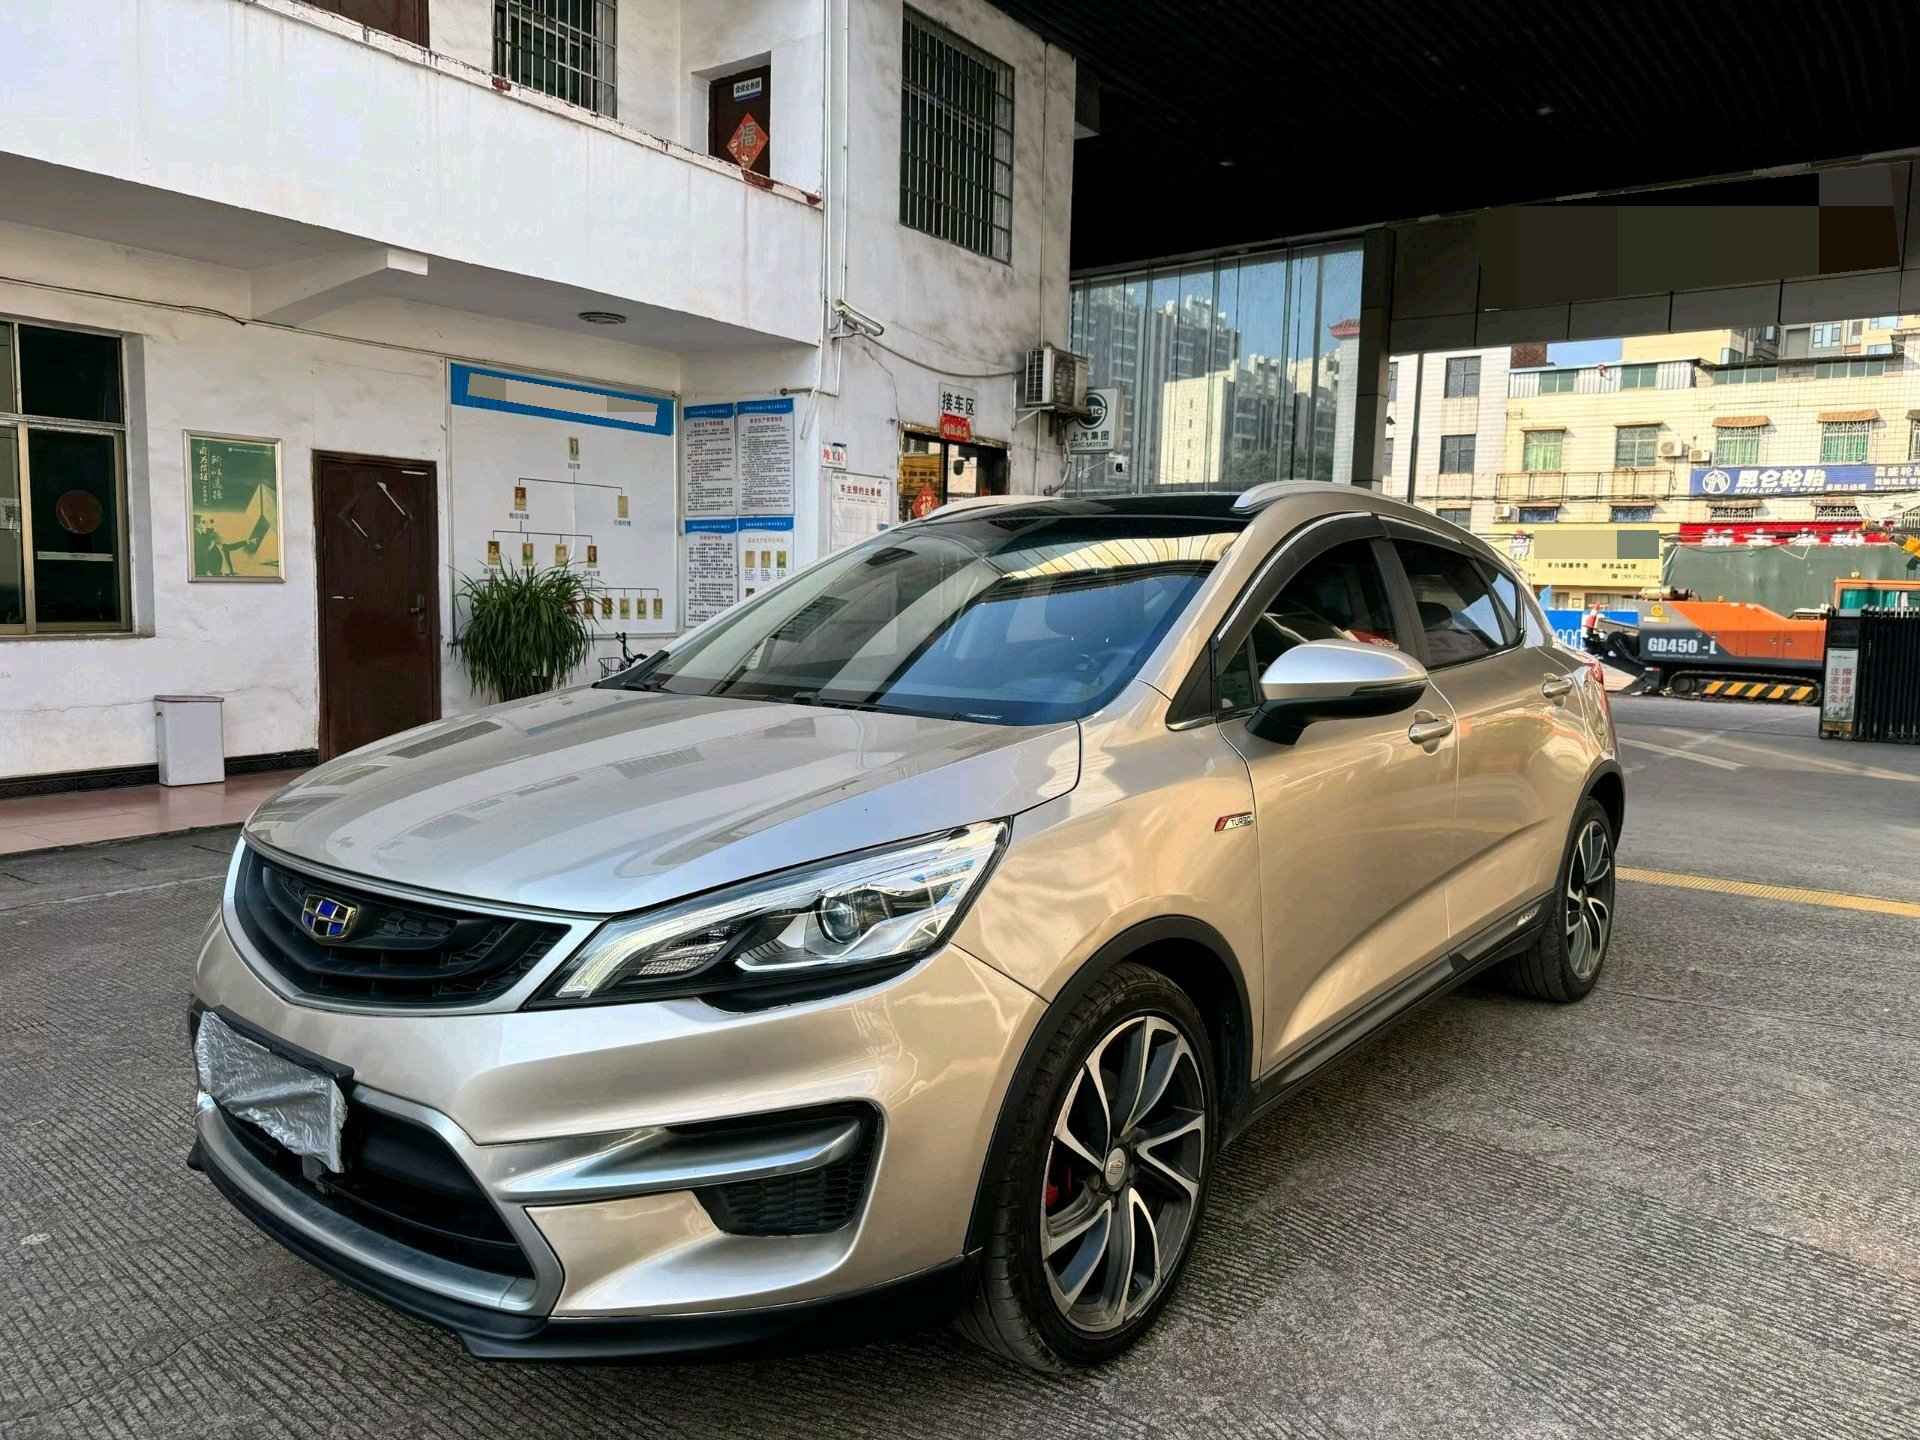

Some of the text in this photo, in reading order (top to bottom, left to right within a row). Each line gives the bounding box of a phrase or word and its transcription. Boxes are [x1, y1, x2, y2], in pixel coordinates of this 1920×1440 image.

[739, 122, 757, 147] 福
[942, 391, 975, 416] 接车区
[1070, 431, 1109, 442] 上汽集团
[1736, 469, 1826, 488] 昆仑轮胎
[1647, 637, 1698, 653] GD450
[1829, 668, 1840, 703] 注意安全
